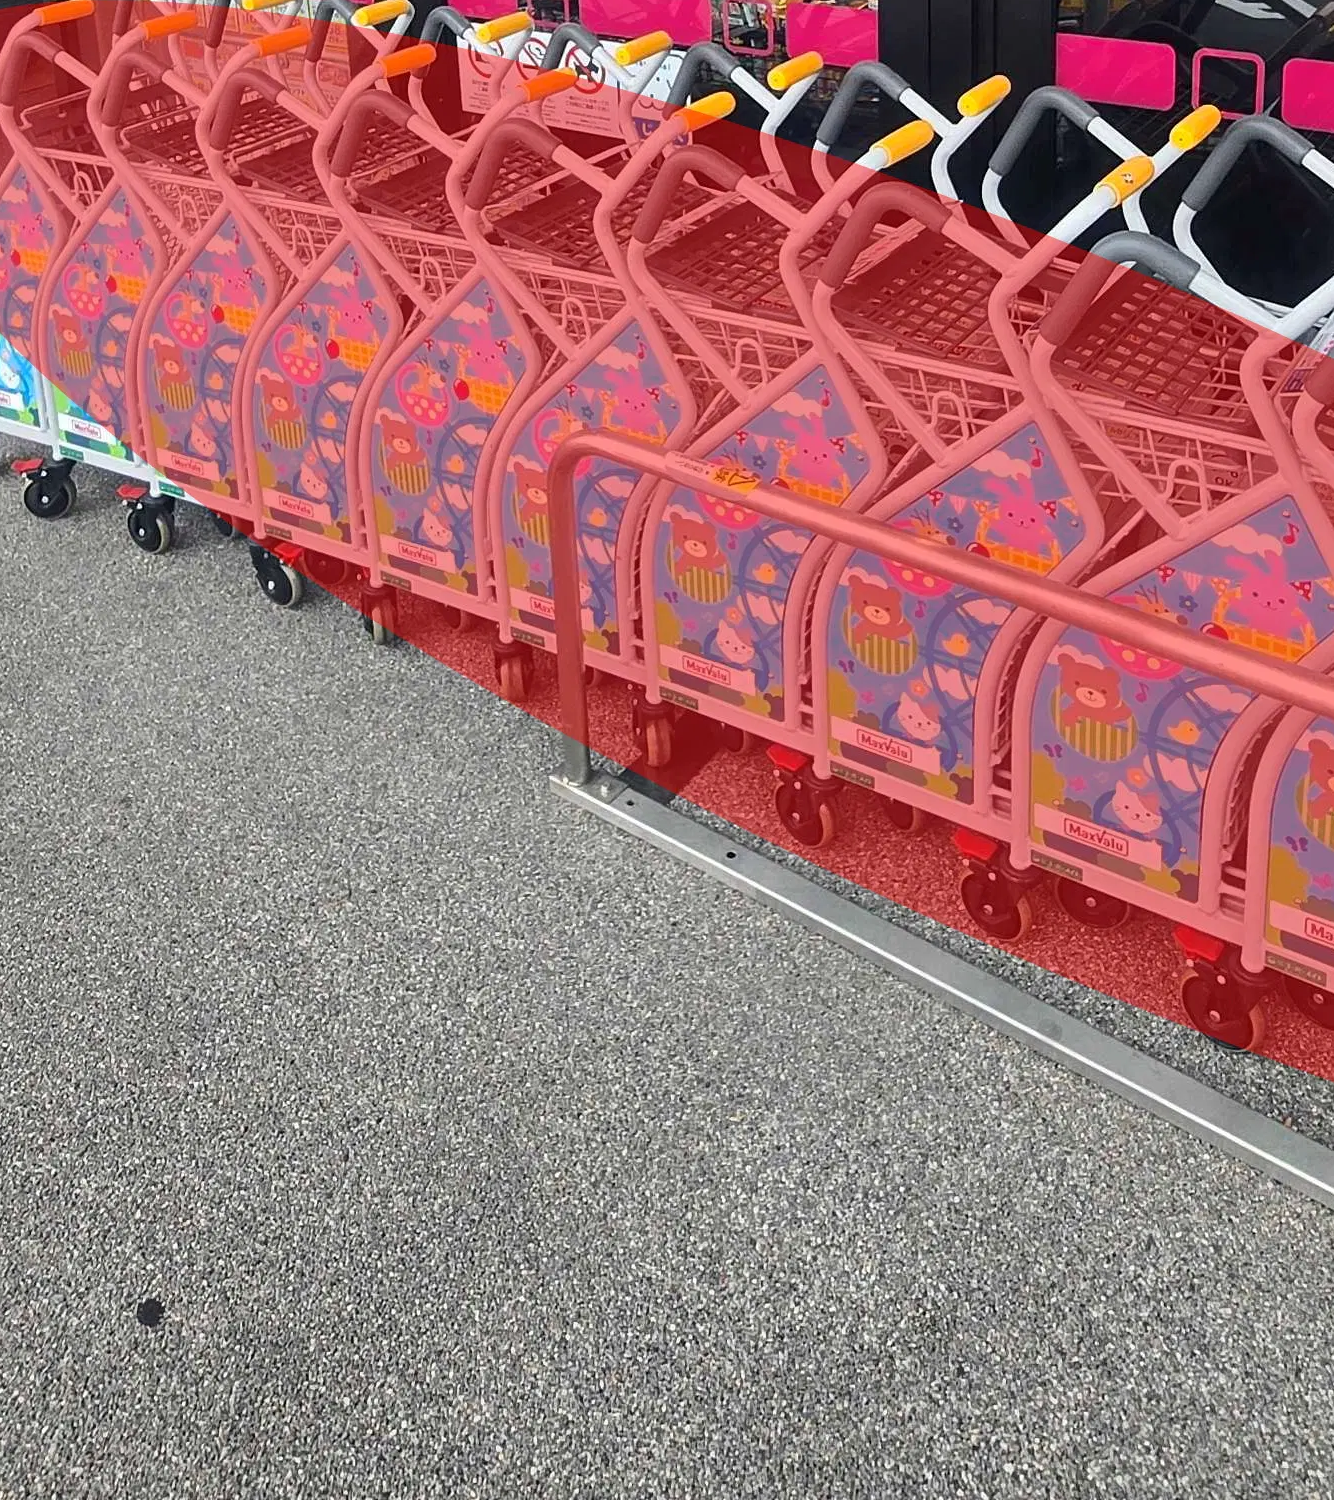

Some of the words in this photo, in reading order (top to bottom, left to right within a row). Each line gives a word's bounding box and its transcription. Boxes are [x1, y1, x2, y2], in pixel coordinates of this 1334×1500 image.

[685, 658, 729, 682] MaxValu
[860, 731, 909, 759] MaxValu
[1068, 821, 1126, 853] MaxValu
